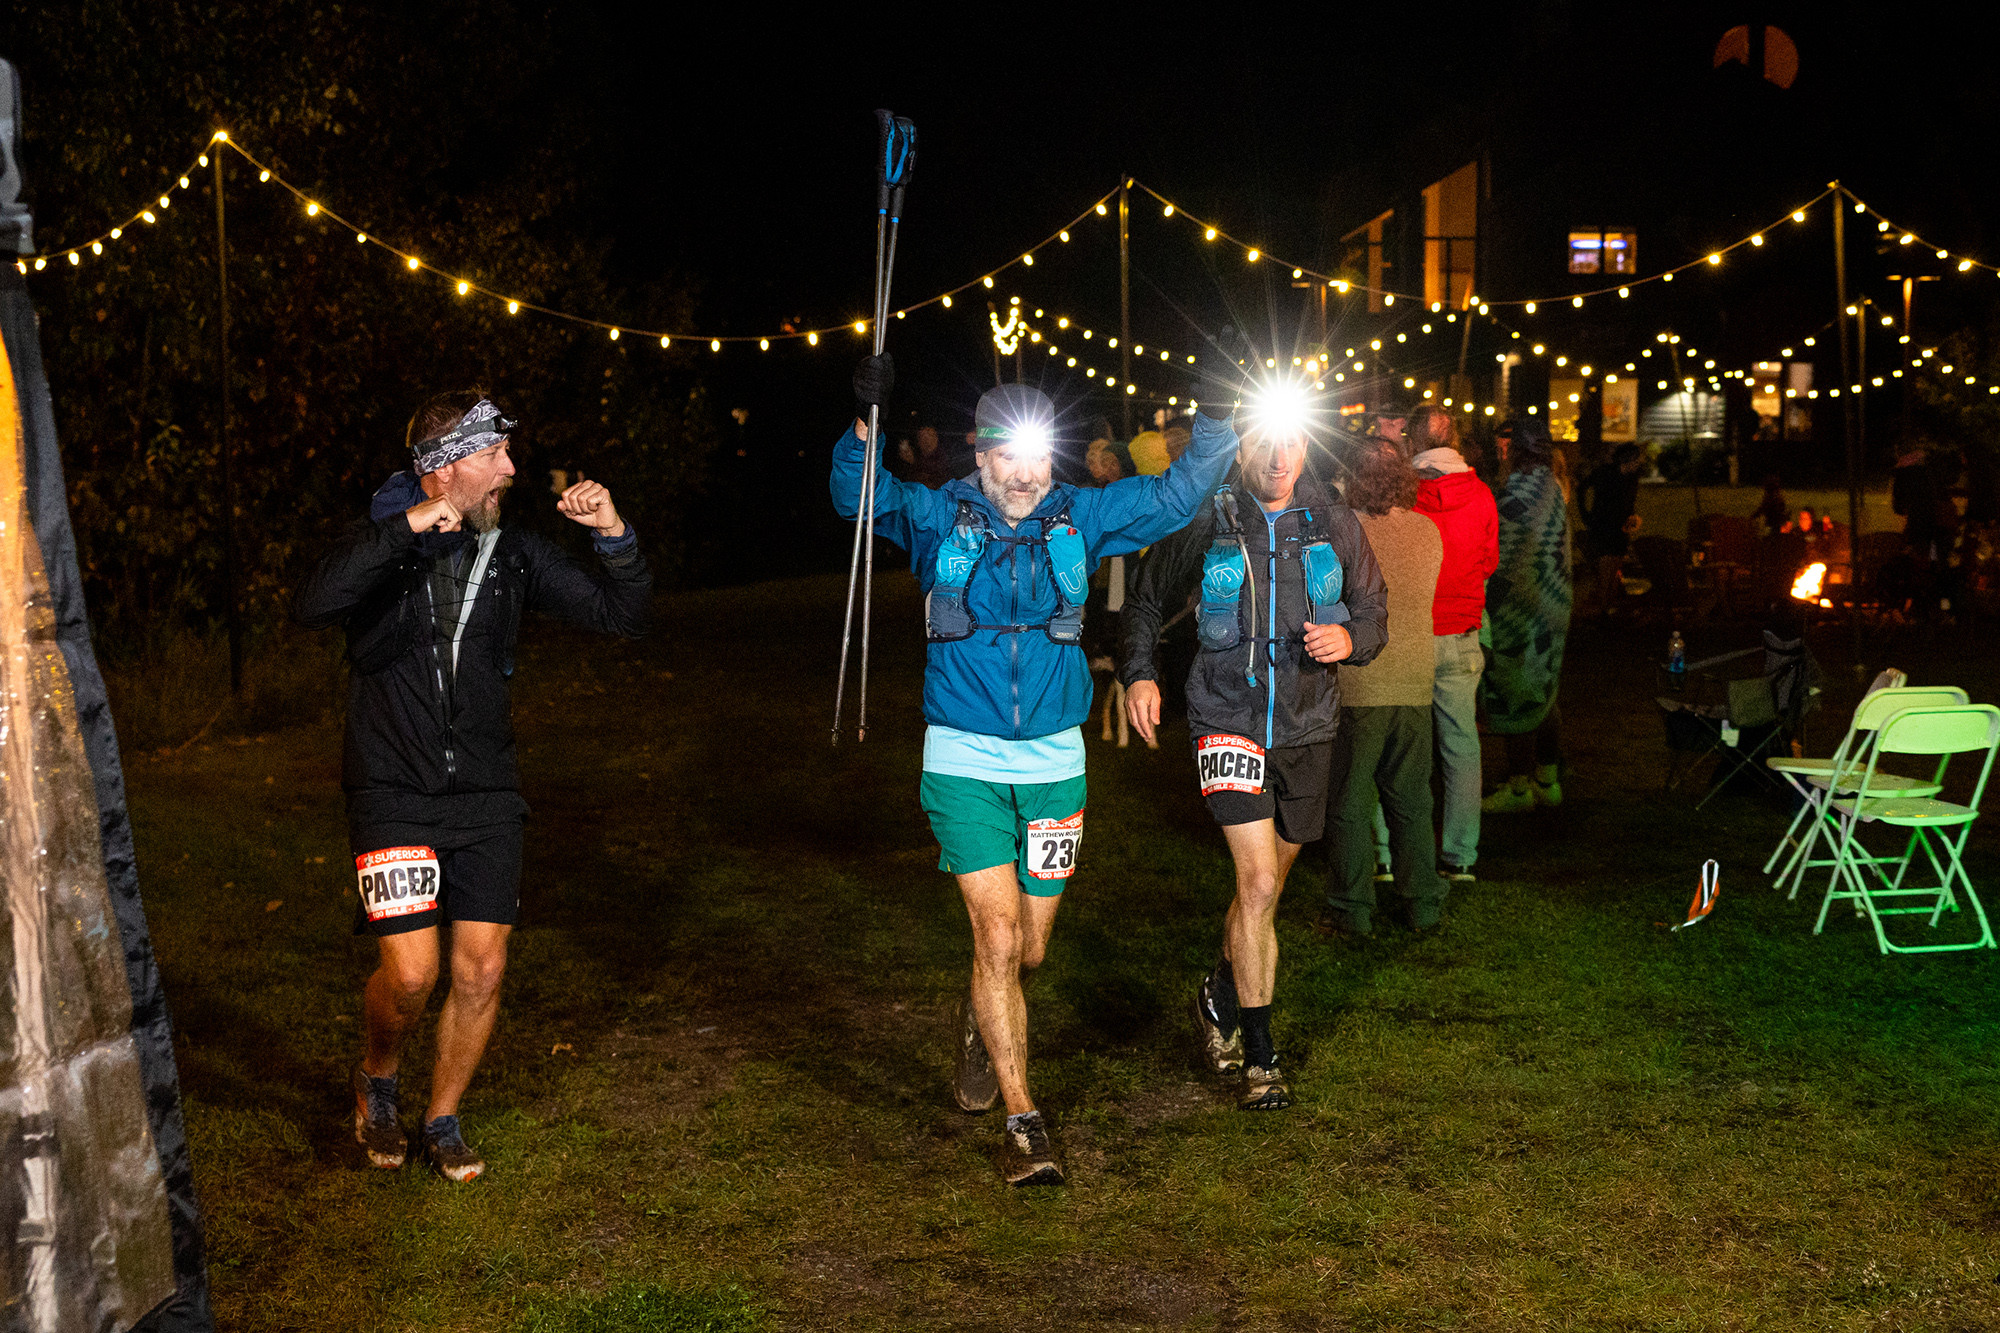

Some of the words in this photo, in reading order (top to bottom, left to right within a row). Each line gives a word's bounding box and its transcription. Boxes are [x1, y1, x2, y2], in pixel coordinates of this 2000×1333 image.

[1212, 736, 1258, 753] SUPERIOR
[1200, 751, 1261, 782] PACER
[1233, 783, 1252, 792] 2025
[1030, 831, 1065, 839] MATTHEW
[374, 849, 428, 864] SUPERIOR
[1041, 838, 1079, 870] 23
[1053, 870, 1070, 878] MILE
[361, 866, 437, 906] PACER
[372, 910, 384, 919] 100
[385, 905, 407, 916] MILE
